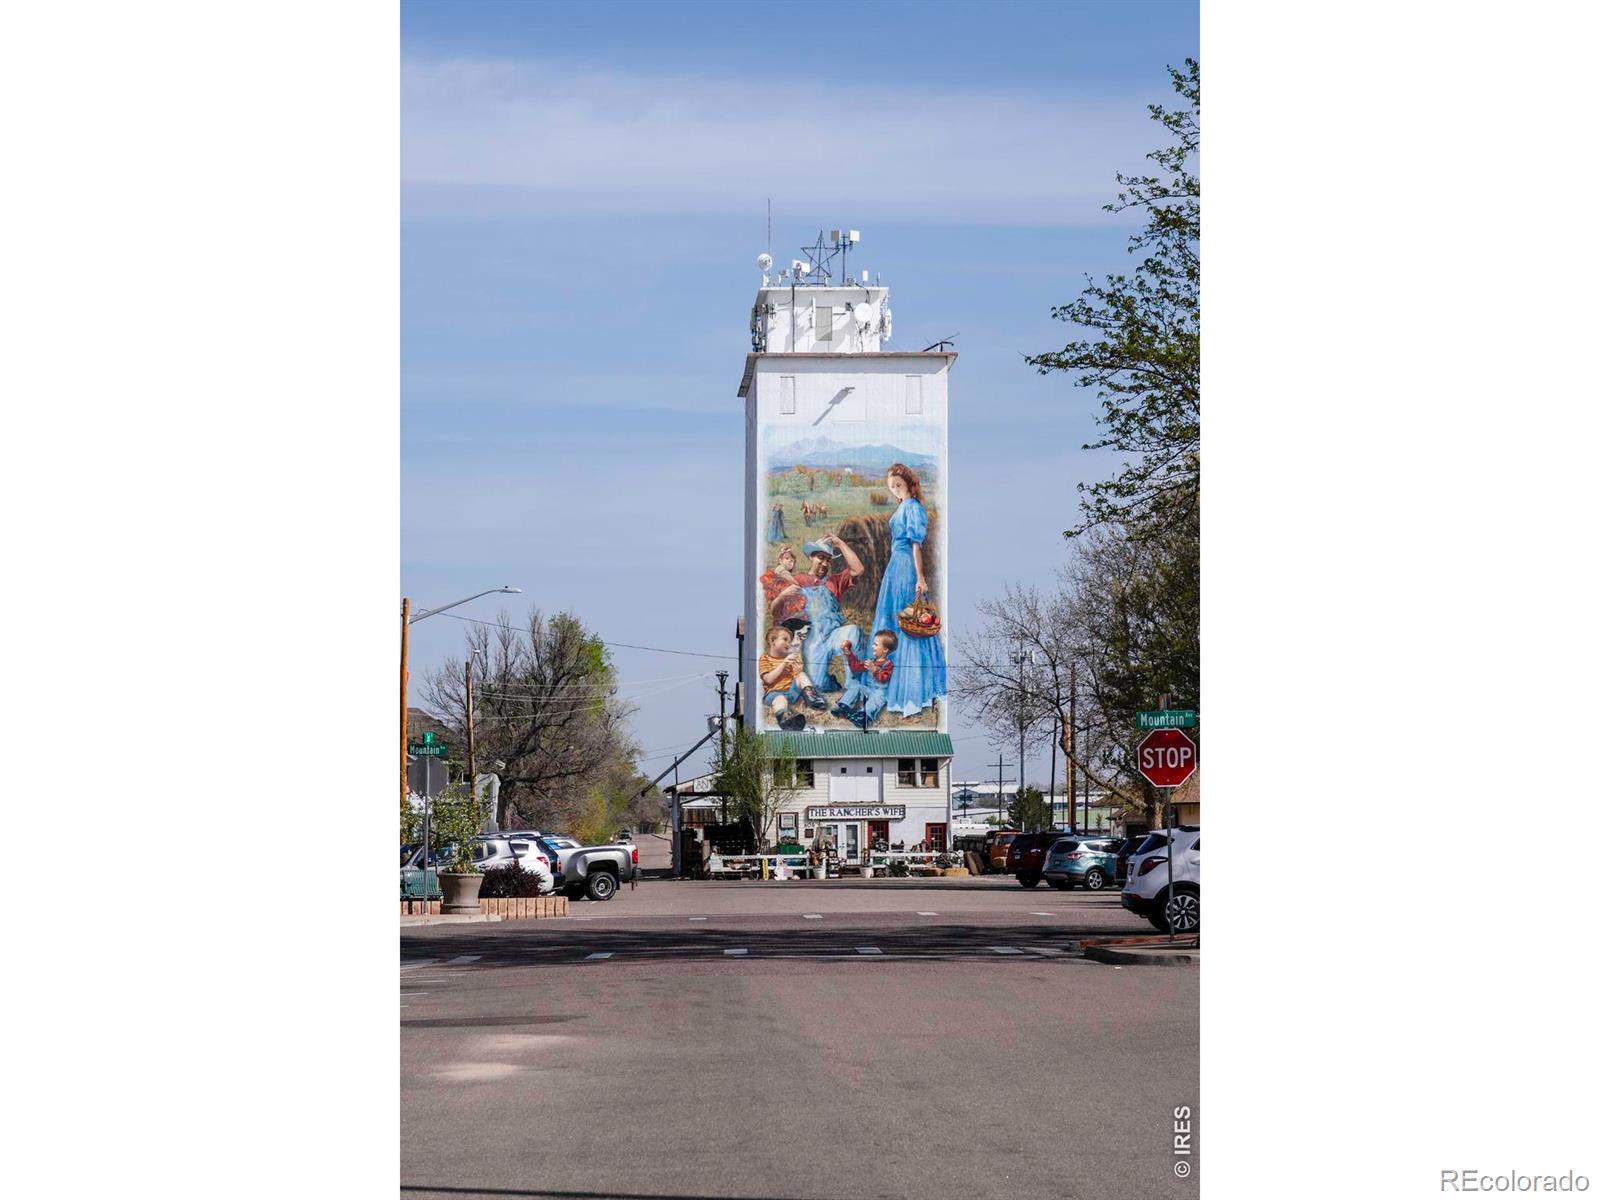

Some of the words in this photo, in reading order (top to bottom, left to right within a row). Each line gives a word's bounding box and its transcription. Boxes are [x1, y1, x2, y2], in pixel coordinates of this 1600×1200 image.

[1140, 713, 1185, 726] Mountain
[410, 744, 440, 755] Mountain
[1142, 747, 1192, 769] STOP
[809, 808, 827, 817] THE
[829, 807, 881, 817] RANCHER'S
[883, 807, 905, 816] WIFE
